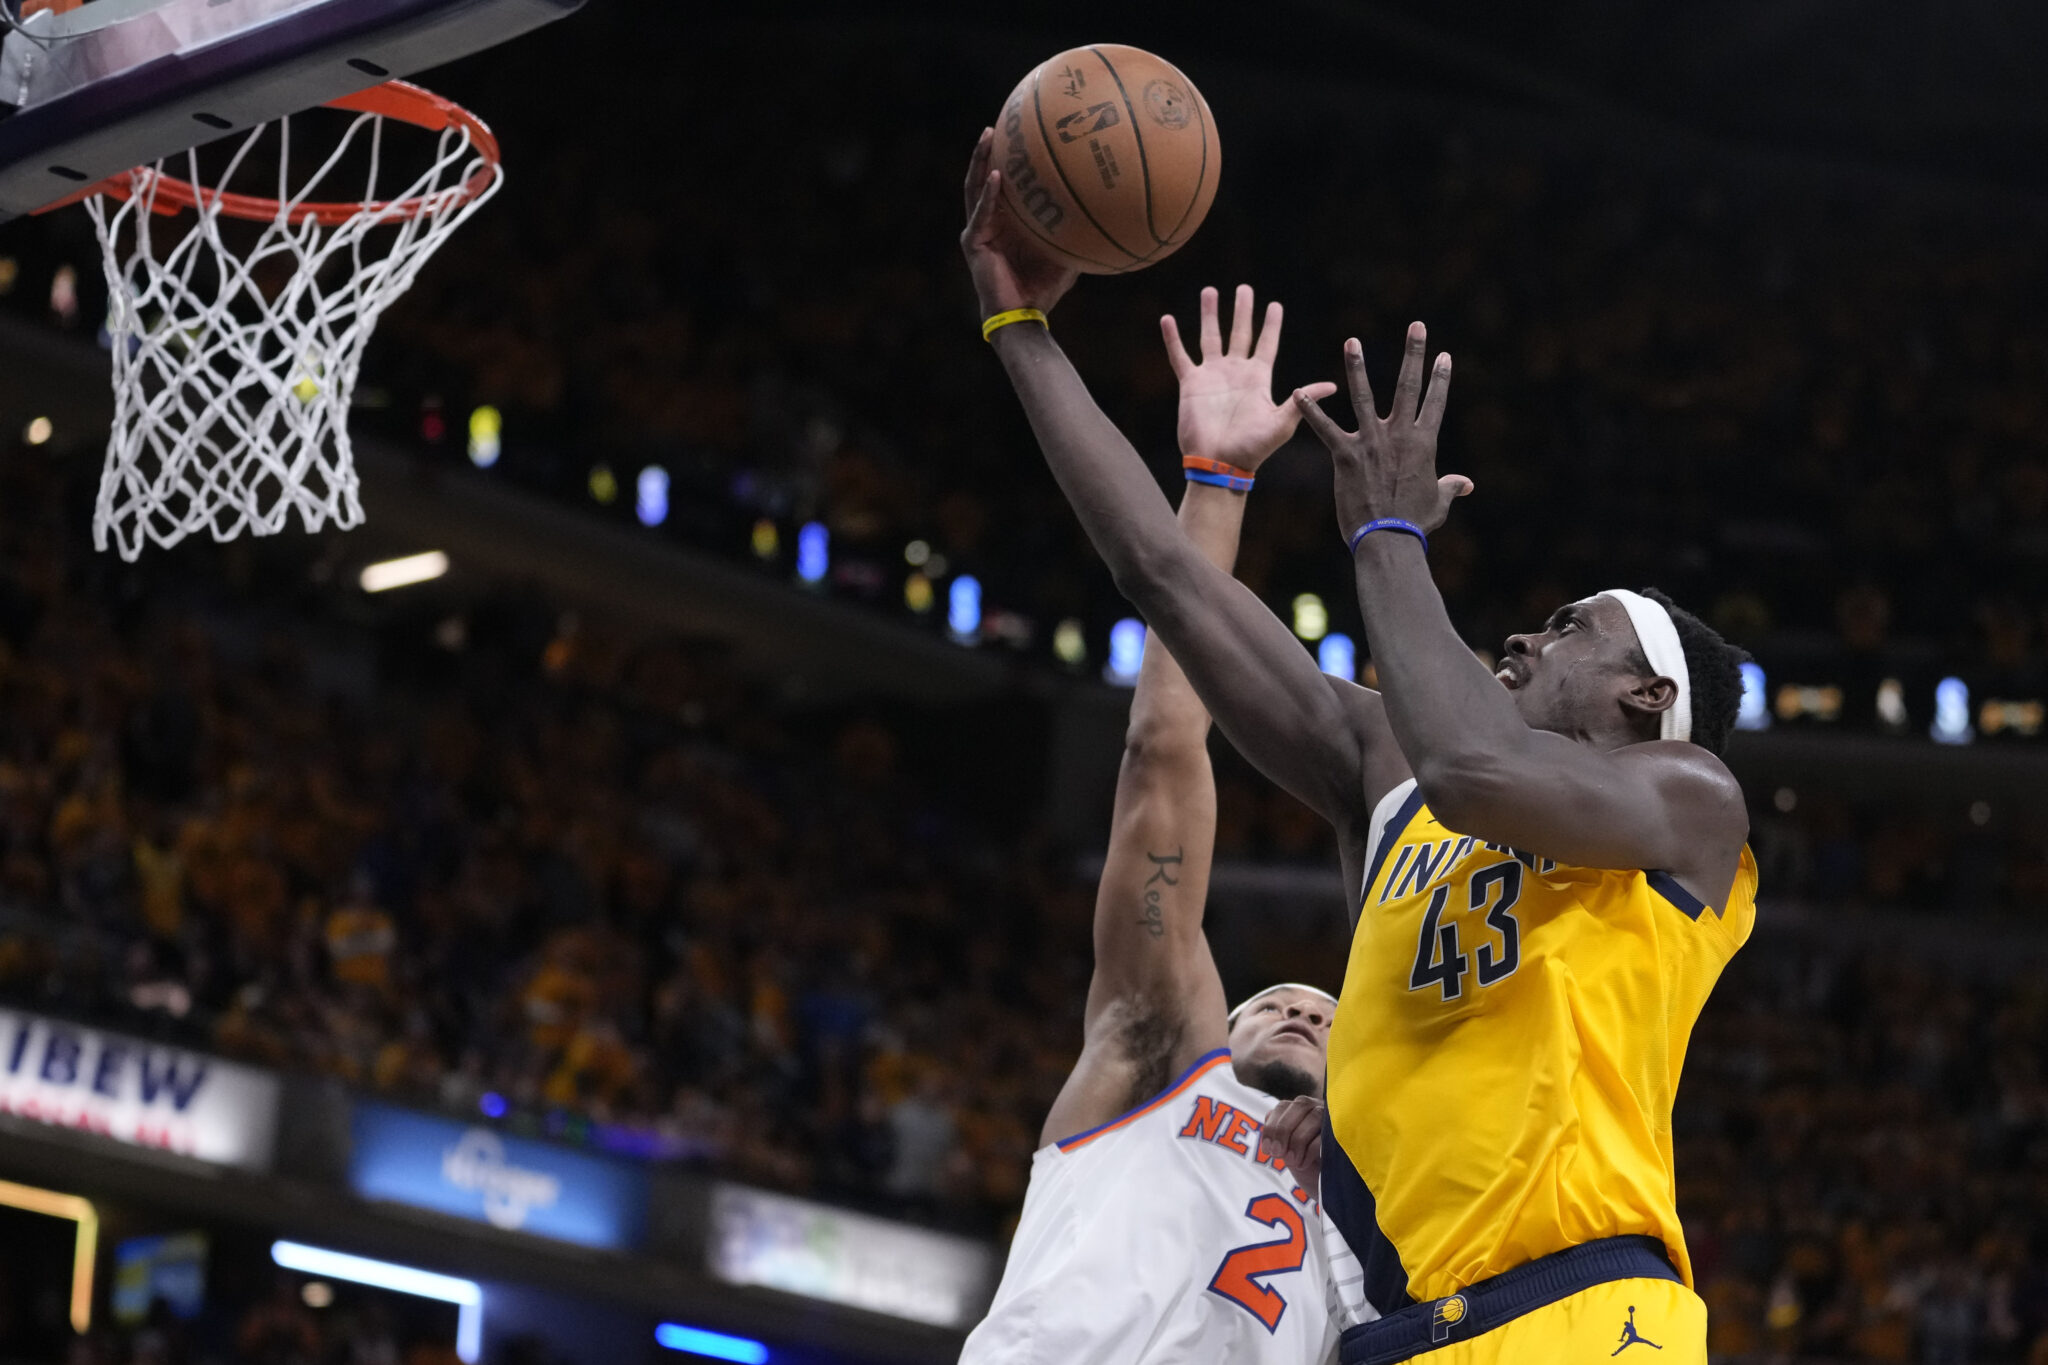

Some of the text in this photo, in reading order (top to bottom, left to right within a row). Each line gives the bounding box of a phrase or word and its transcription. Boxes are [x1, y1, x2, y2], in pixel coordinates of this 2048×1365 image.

[1136, 845, 1184, 940] Keep
[1409, 858, 1525, 1002] 43
[7, 1024, 208, 1112] IBEW
[1206, 1192, 1308, 1336] 2
